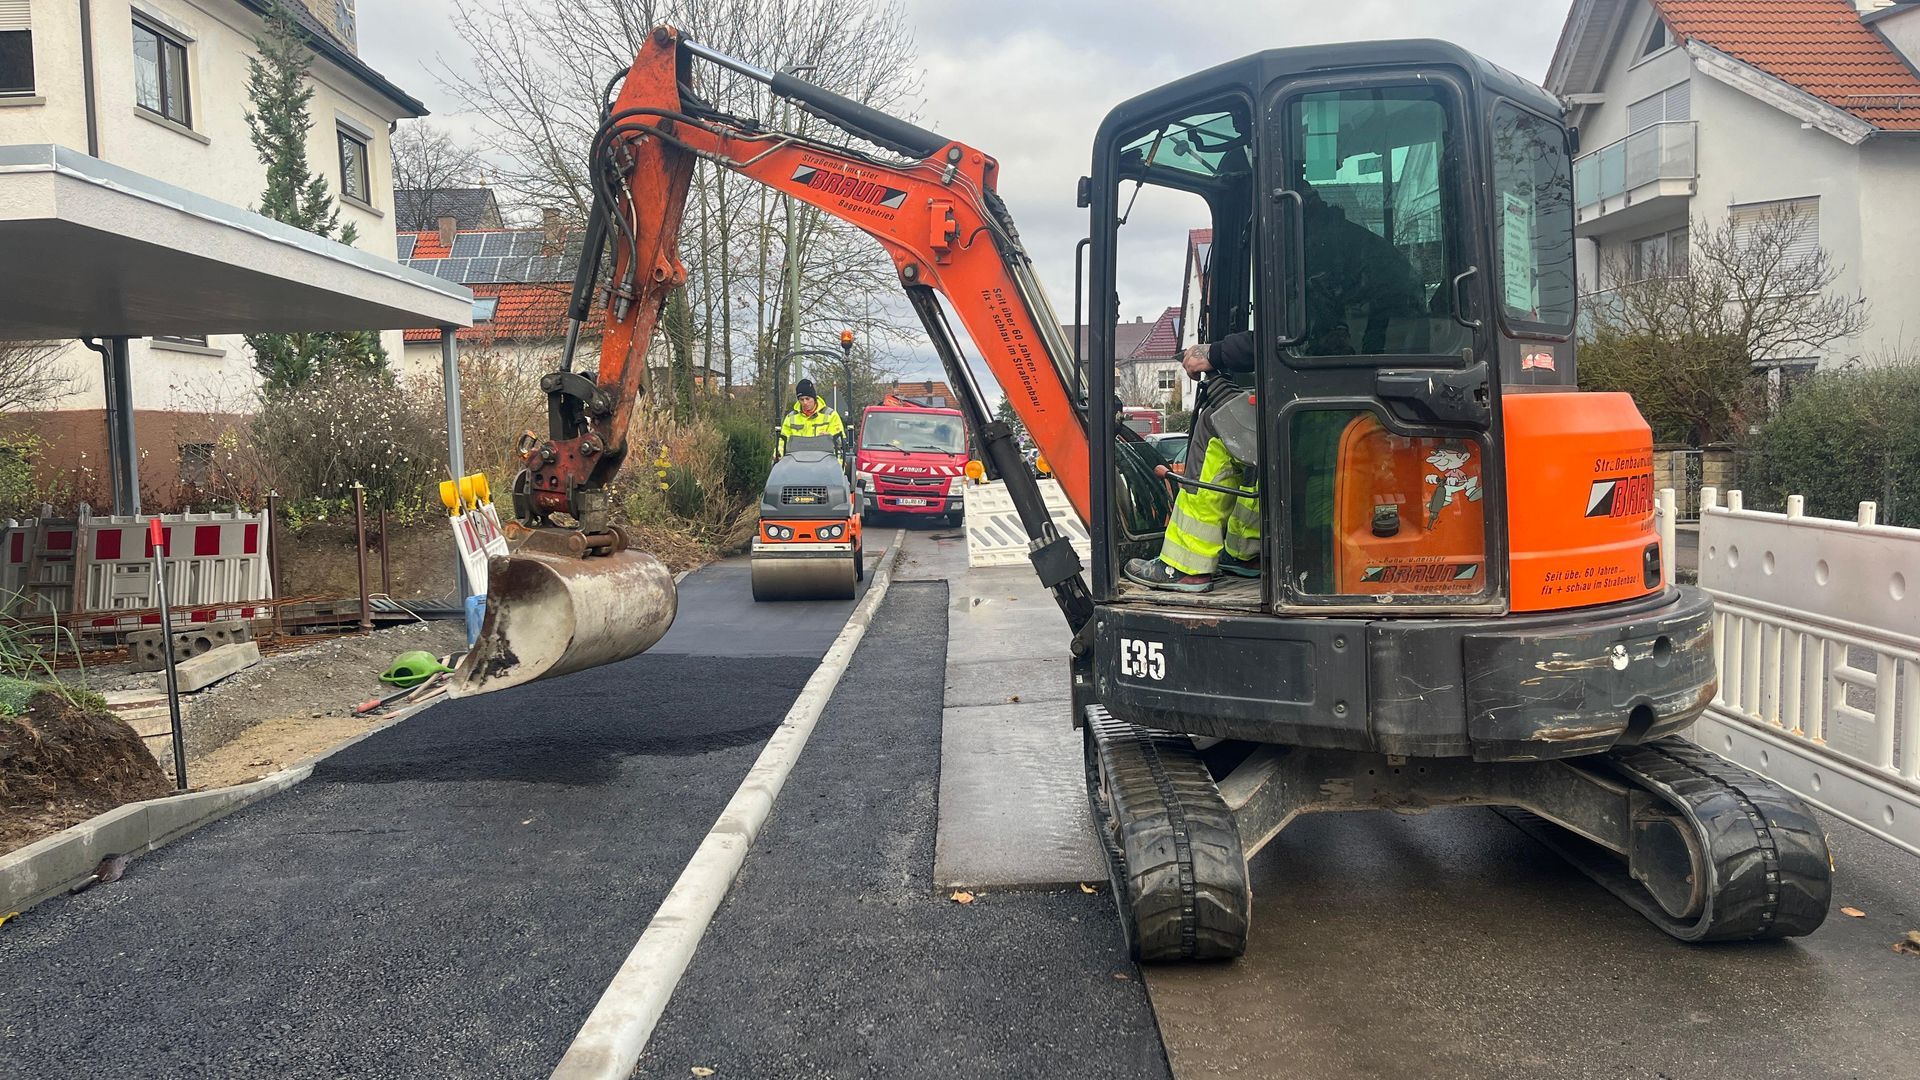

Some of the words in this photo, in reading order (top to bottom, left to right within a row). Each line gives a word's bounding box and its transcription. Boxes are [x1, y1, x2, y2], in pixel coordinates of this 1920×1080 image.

[807, 169, 887, 206] BRAUN
[838, 199, 895, 220] Baggerbetrieb
[981, 289, 991, 301] fix
[992, 314, 1011, 342] schlau
[1006, 344, 1016, 356] im
[1013, 357, 1040, 406] Straßenbau
[993, 287, 1007, 305] Seit
[1001, 307, 1016, 326] über
[1012, 329, 1024, 340] 60
[1018, 343, 1037, 372] Jahren
[1609, 472, 1654, 518] BRAU
[1379, 564, 1457, 583] BRAUN
[1541, 586, 1553, 595] fix
[1593, 580, 1602, 589] im
[1603, 576, 1636, 588] Straßenbau
[1545, 571, 1562, 582] Seit
[1565, 569, 1581, 580] übe
[1584, 567, 1594, 578] 60
[1120, 638, 1166, 680] E35
